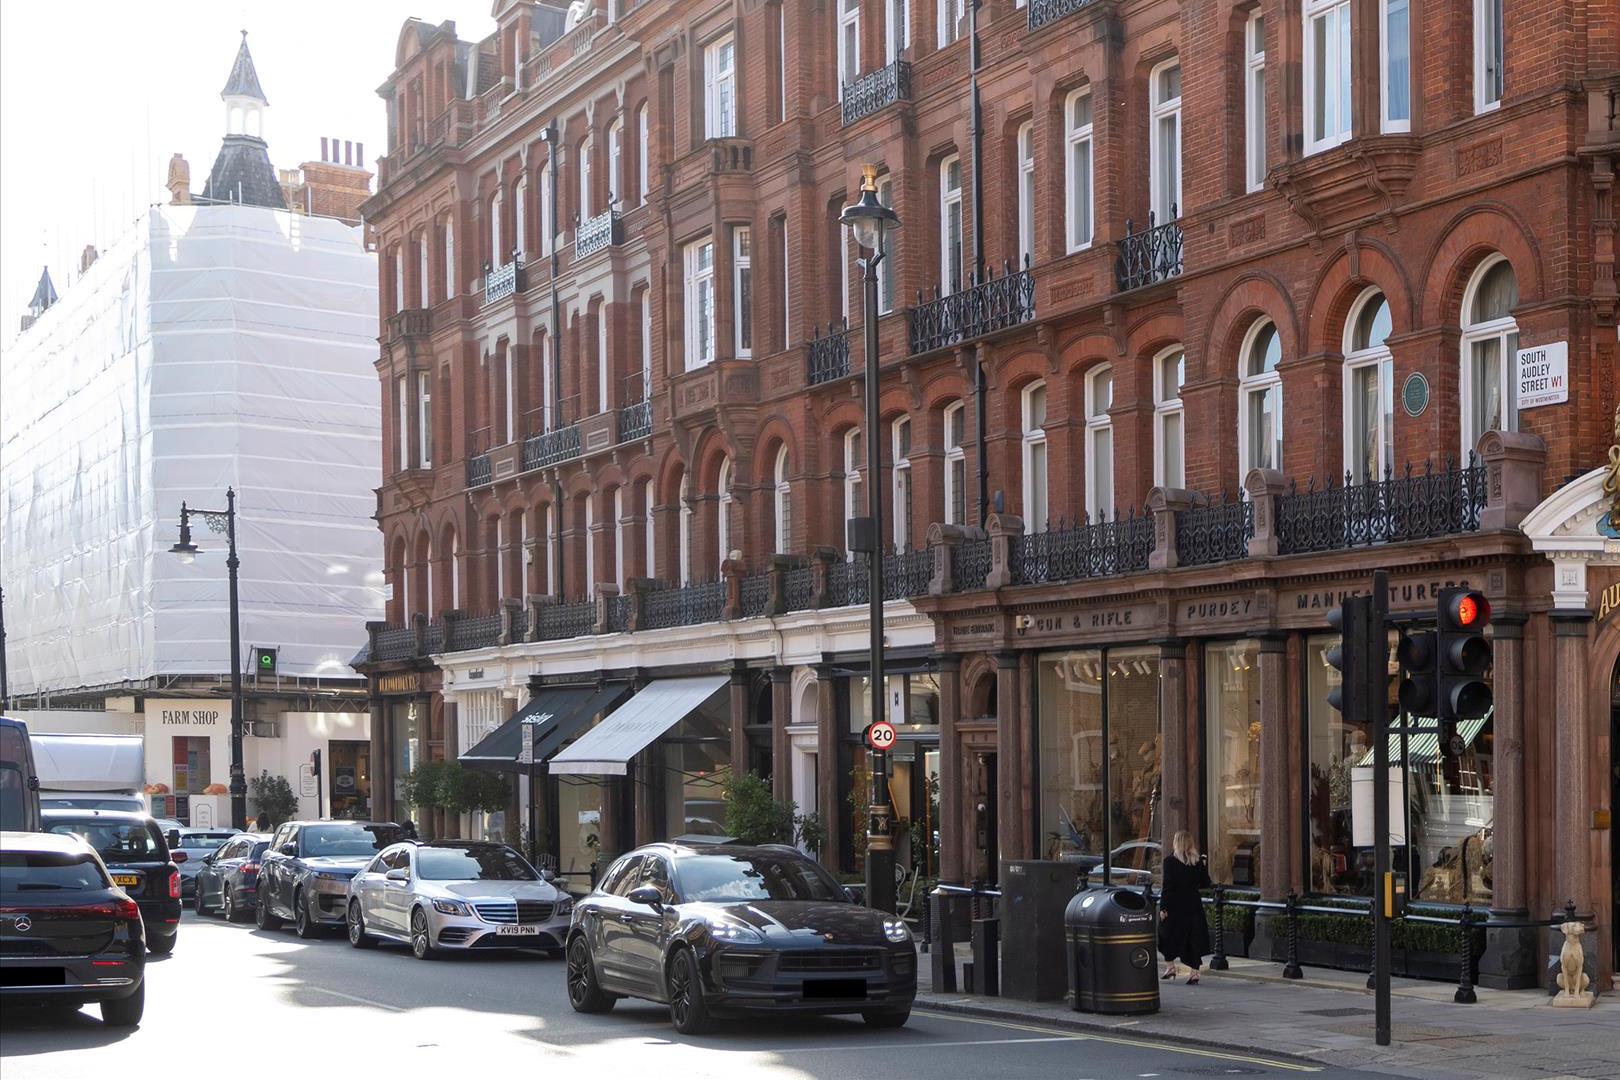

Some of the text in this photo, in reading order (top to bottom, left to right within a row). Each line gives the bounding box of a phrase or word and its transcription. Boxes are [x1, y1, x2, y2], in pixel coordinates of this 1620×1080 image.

[1521, 350, 1546, 365] SOUTH
[1522, 364, 1550, 379] AUDLEY
[1521, 376, 1562, 393] STREET W1
[1187, 599, 1251, 618] PURDEY
[1037, 611, 1132, 632] GUN & RIFLE
[162, 710, 219, 725] FARM SHOP
[873, 729, 893, 742] 20
